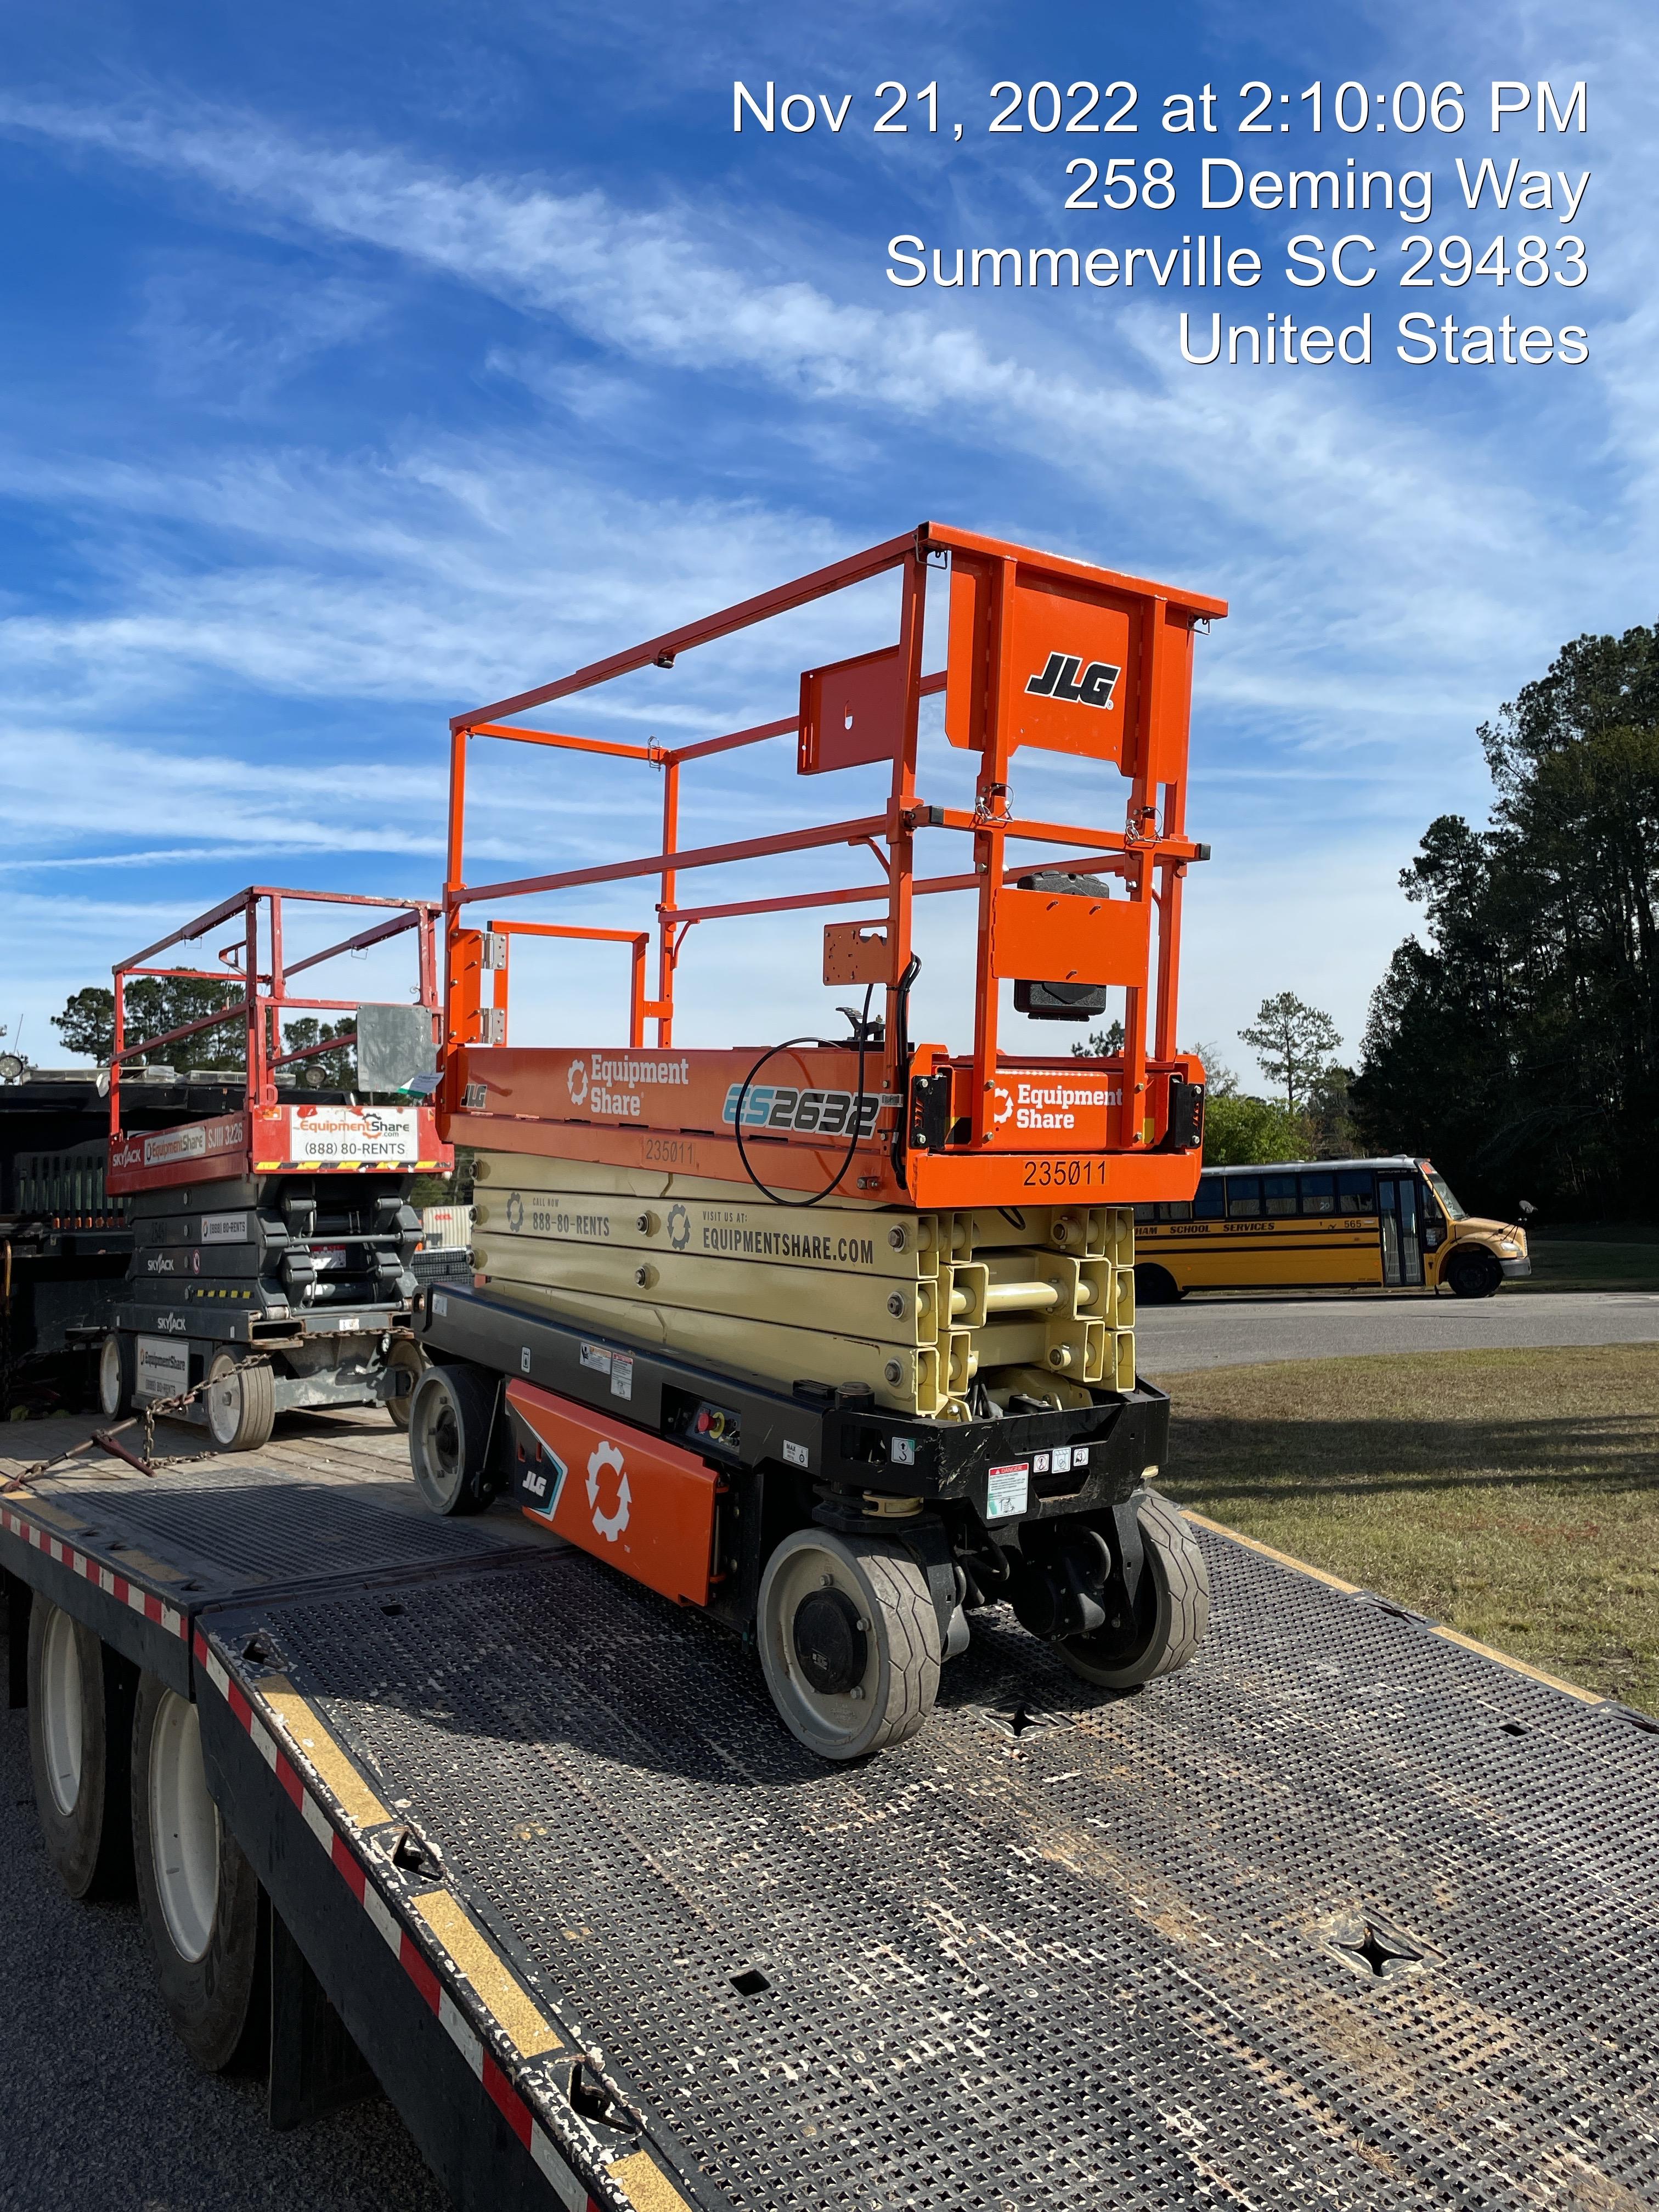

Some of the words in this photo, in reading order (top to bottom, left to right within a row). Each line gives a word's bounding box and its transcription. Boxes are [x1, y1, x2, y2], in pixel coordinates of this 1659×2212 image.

[1024, 651, 1121, 709] JLG
[591, 1054, 689, 1088] Equipment
[460, 1084, 487, 1109] JLG
[591, 1086, 640, 1116] Share
[1017, 1084, 1122, 1109] Equipment
[723, 1084, 881, 1139] ES2632
[1017, 1109, 1075, 1129] Share
[225, 1122, 243, 1145] 3226
[300, 1120, 409, 1133] EquipmentShare
[112, 1144, 141, 1168] SKYJACK
[152, 1135, 203, 1160] EquipmentShare
[306, 1143, 337, 1155] (888)
[341, 1143, 405, 1154] 80-RENTS
[646, 1139, 693, 1165] 235011
[1023, 1160, 1107, 1187] 235011
[533, 1198, 545, 1207] CALL
[548, 1198, 559, 1207] NOW
[533, 1212, 610, 1237] 888-80-RENTS
[703, 1211, 721, 1222] VISIT
[724, 1212, 733, 1222] US
[736, 1213, 747, 1223] AT:
[1170, 1225, 1210, 1234] SCHOOL
[1223, 1222, 1274, 1232] SERVICES
[1344, 1220, 1361, 1228] 565
[703, 1227, 873, 1265] EQUIPMENTSHARE.COM
[147, 1252, 174, 1274] SKYJACK
[157, 1312, 187, 1333] SKYJACK
[786, 1443, 795, 1452] MAX
[522, 1470, 547, 1497] JLG
